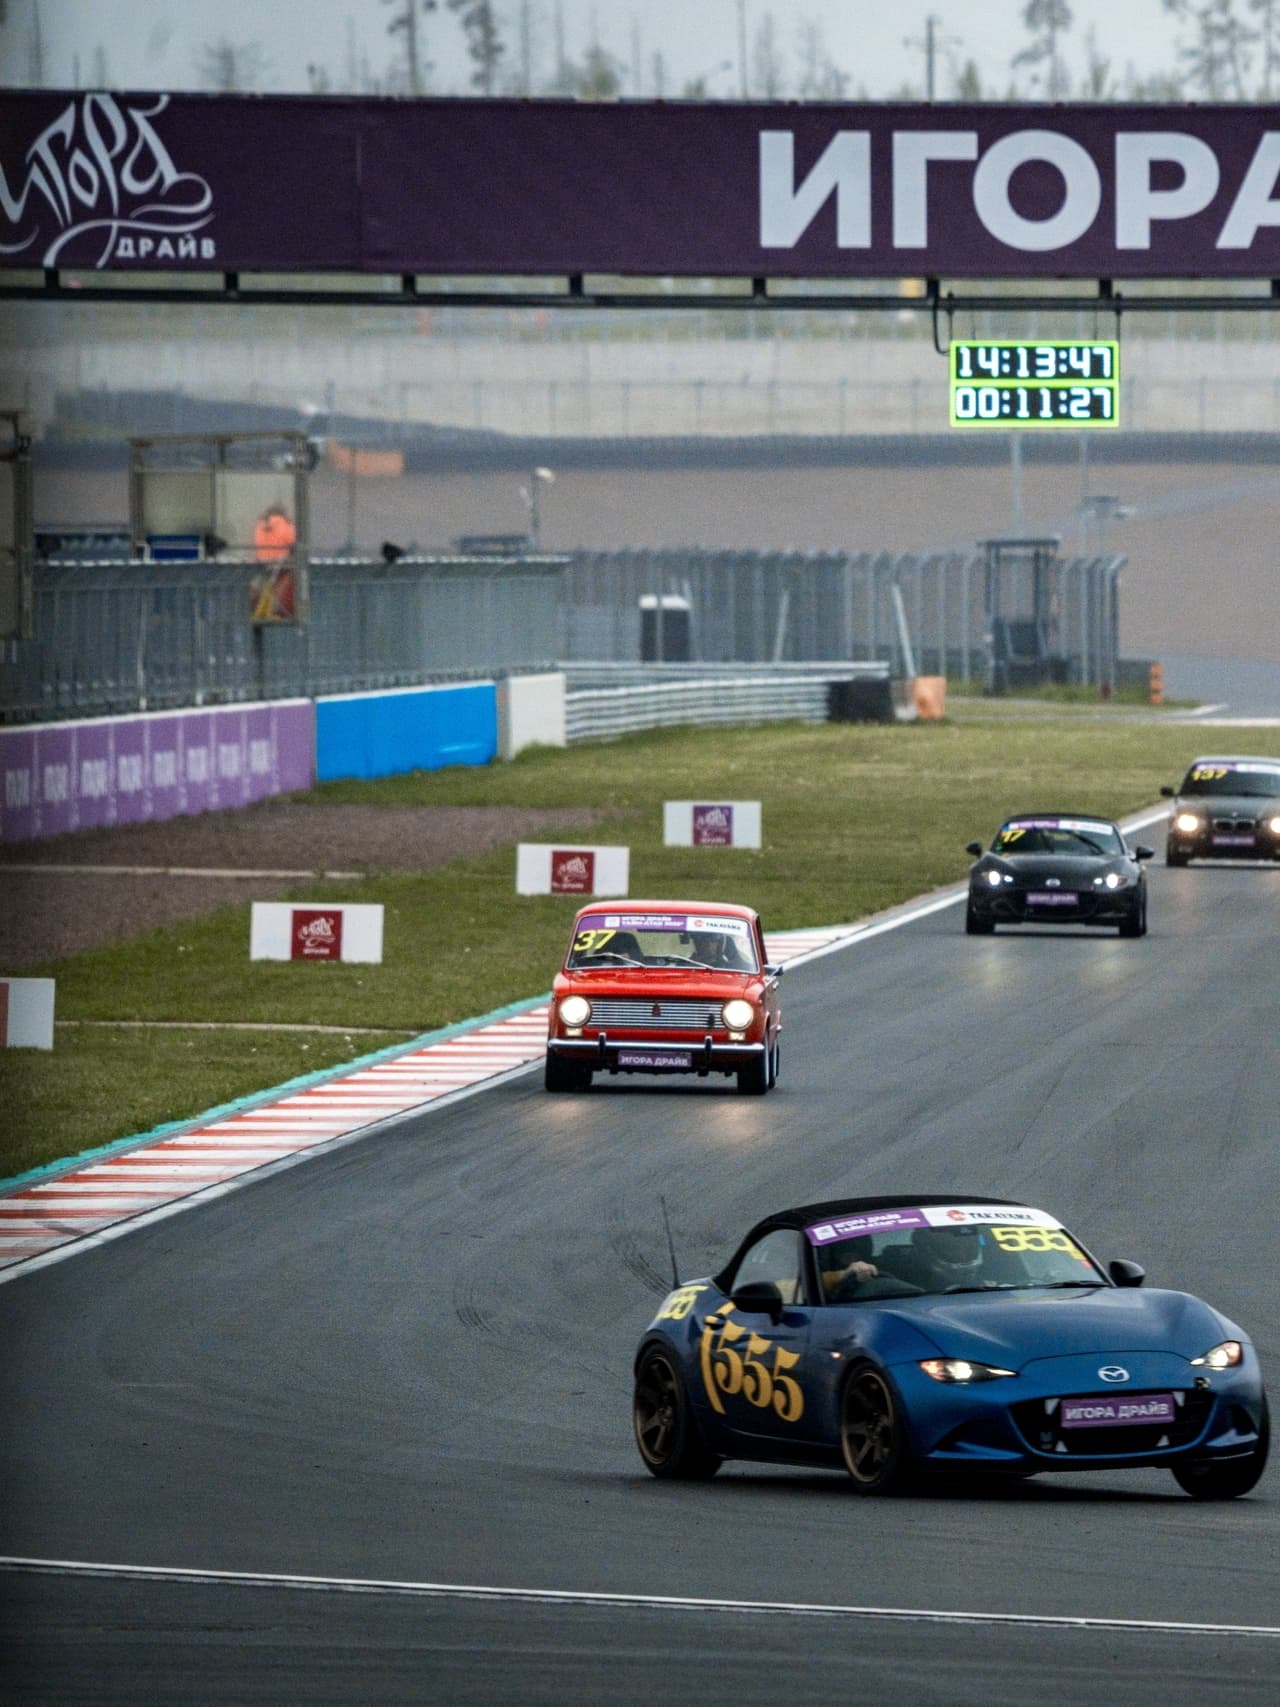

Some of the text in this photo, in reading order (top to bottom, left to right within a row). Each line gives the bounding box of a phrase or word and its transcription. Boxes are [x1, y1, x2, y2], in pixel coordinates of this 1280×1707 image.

[115, 232, 217, 260] ДРАЙВ
[958, 346, 1112, 378] 14:13:47
[955, 386, 1112, 419] 00:11:27
[573, 929, 617, 952] 37
[621, 1055, 653, 1065] ИГОРА
[991, 1226, 1074, 1252] 555
[1065, 1401, 1169, 1420] ИГОРА ДРАЙВ
